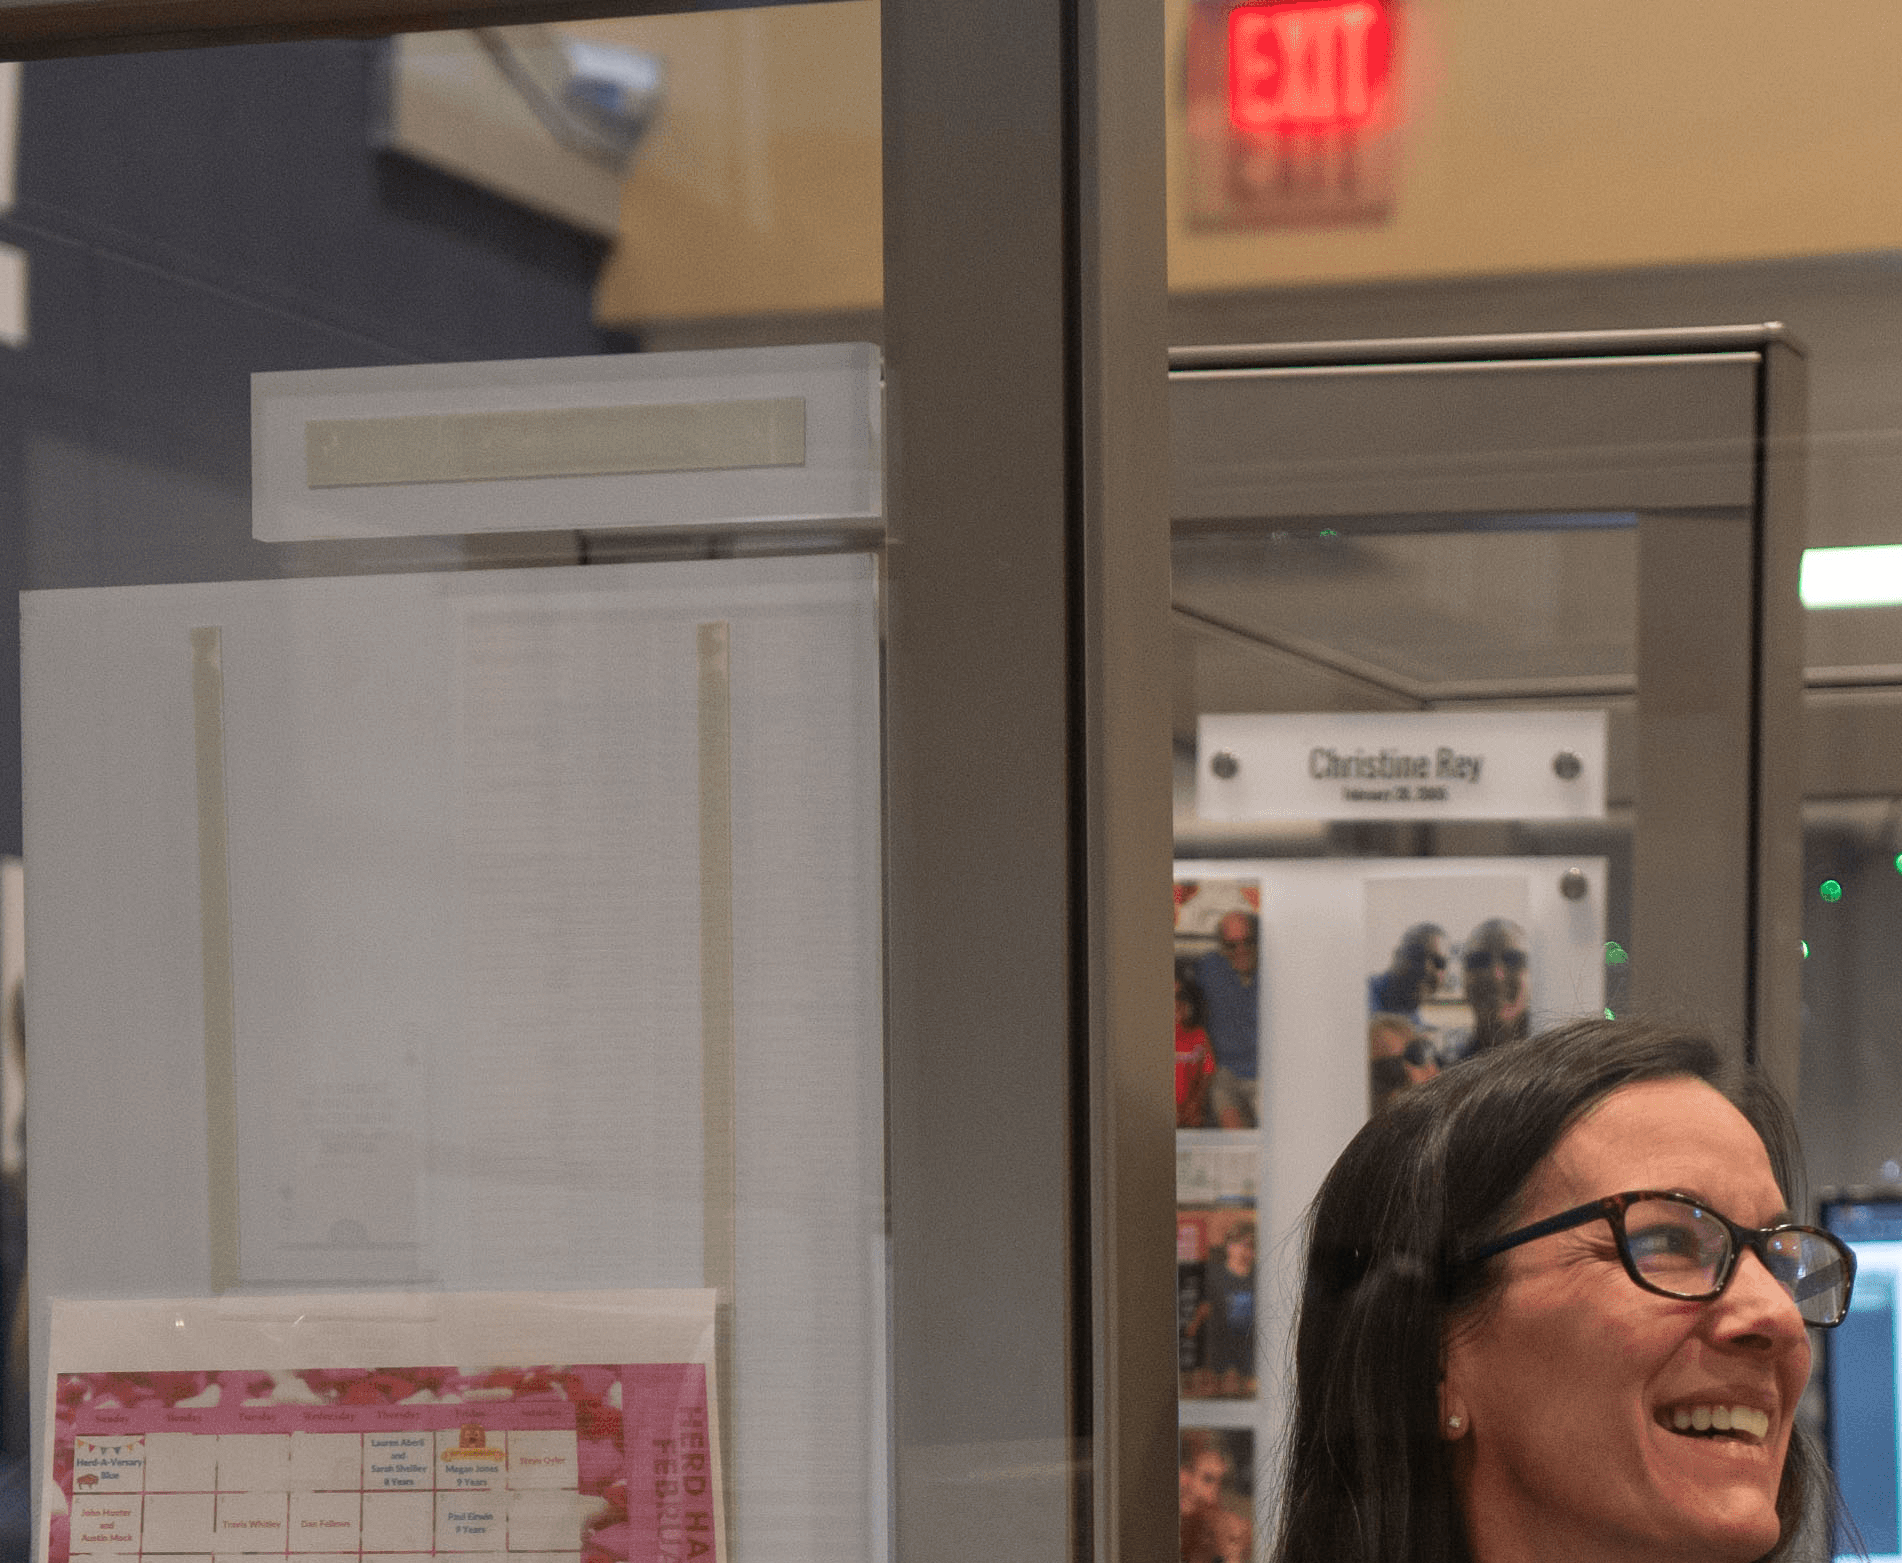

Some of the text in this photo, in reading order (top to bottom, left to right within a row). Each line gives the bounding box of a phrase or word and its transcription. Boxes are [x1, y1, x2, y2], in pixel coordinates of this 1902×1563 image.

[1236, 5, 1380, 123] EXIT
[1308, 746, 1484, 785] Christine Rey
